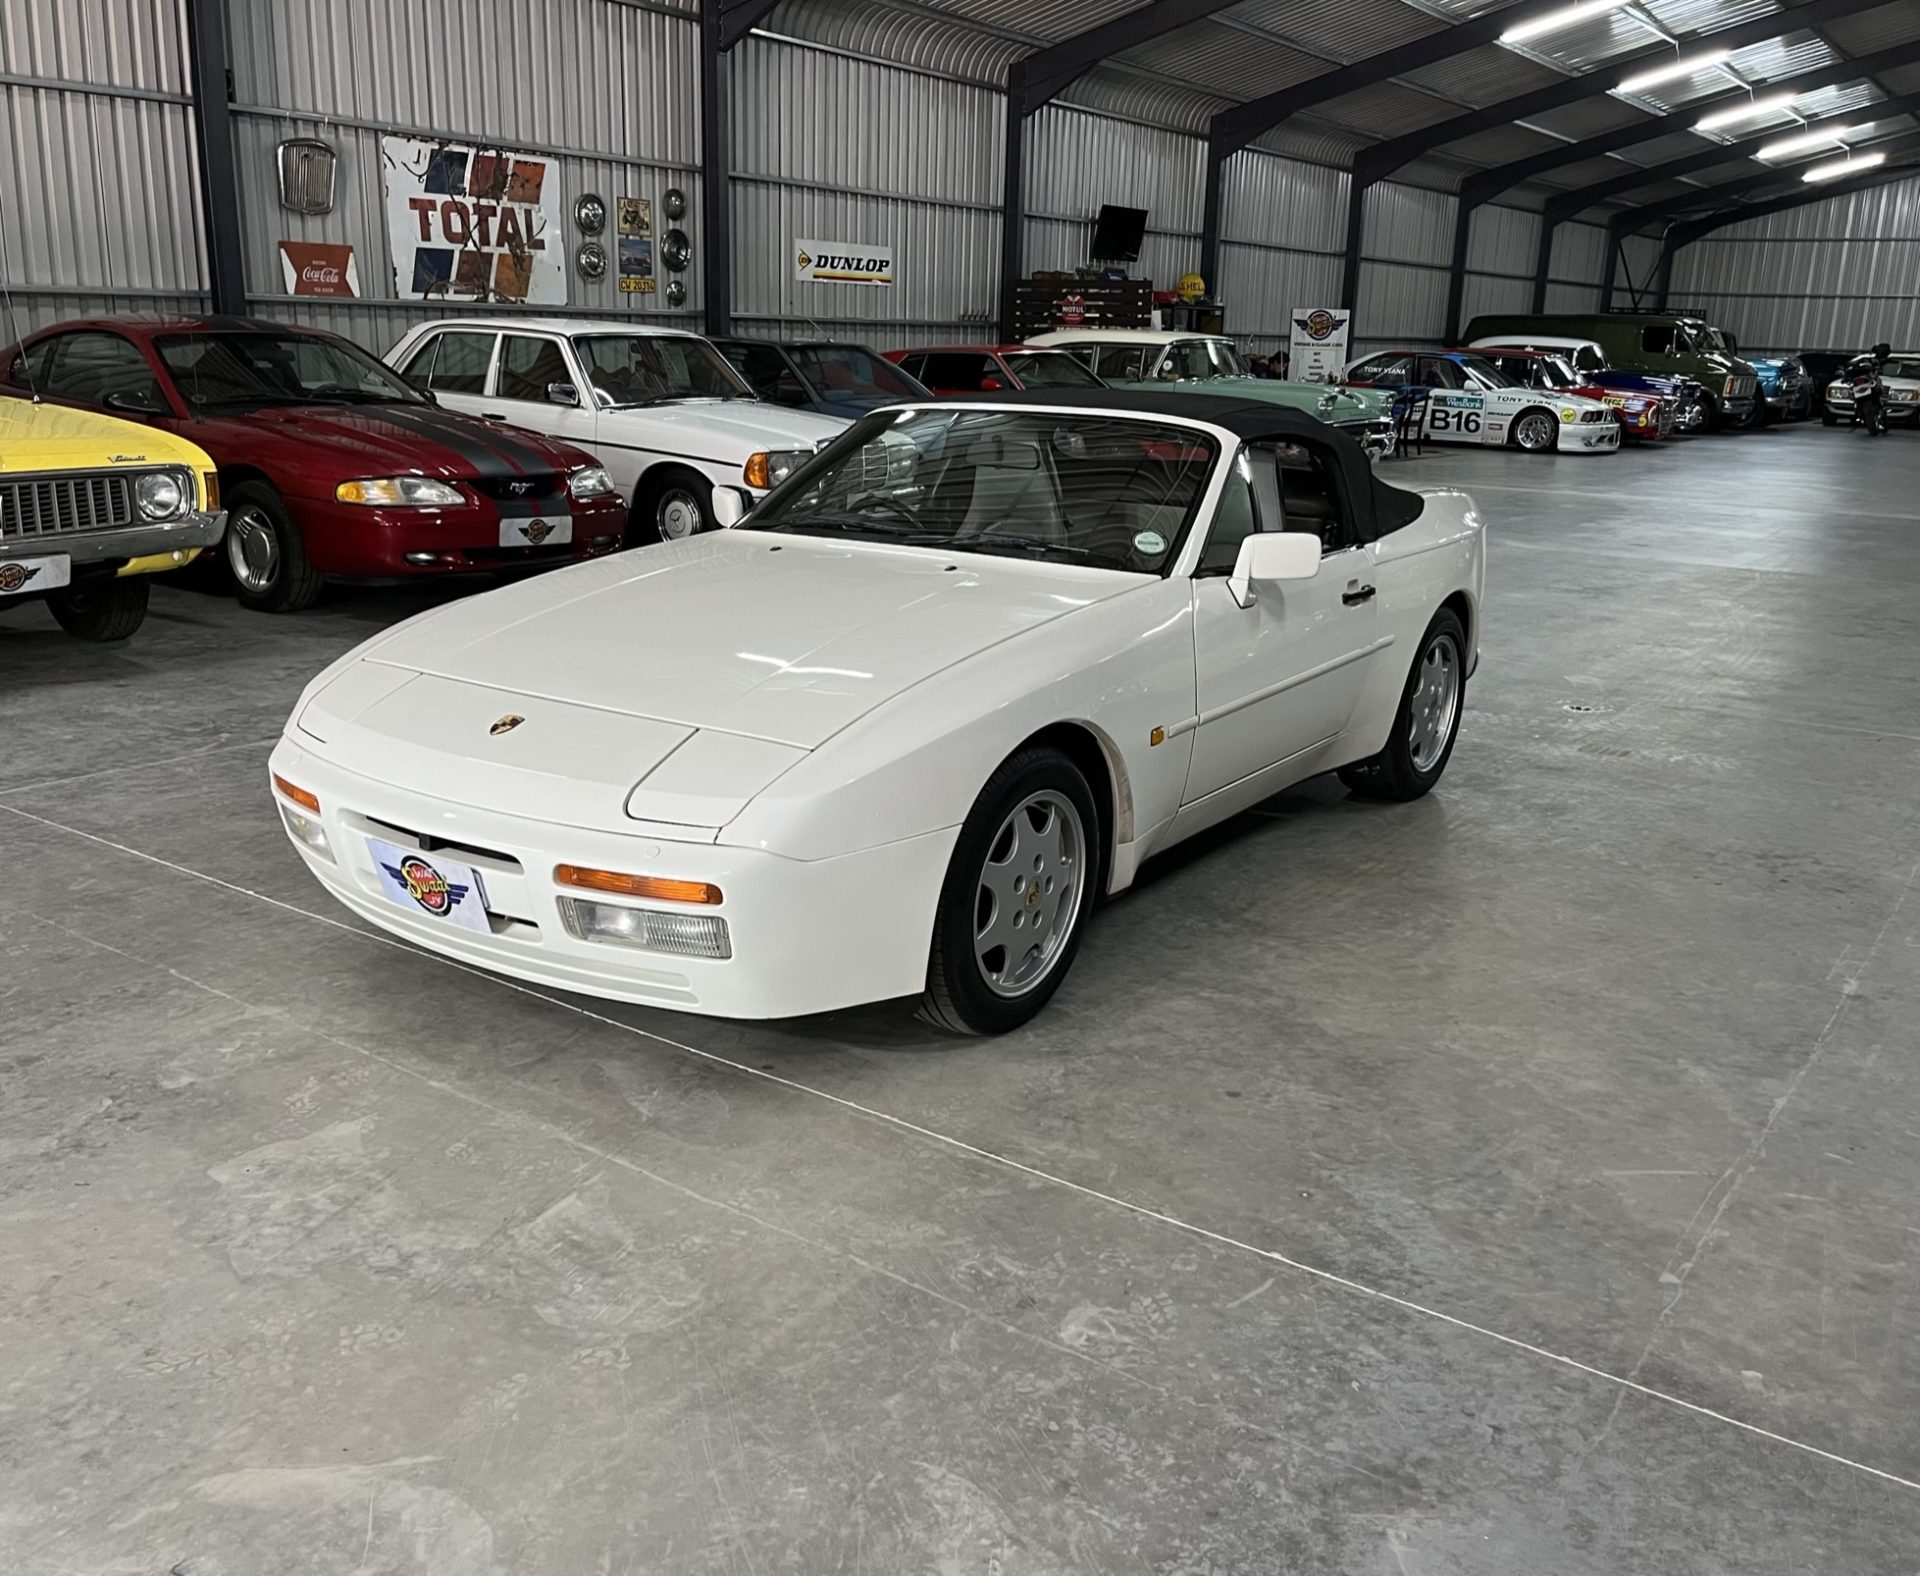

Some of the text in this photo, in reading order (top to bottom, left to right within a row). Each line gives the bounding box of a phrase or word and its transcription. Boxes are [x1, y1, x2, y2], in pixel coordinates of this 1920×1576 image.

[409, 197, 546, 250] TOTAL
[814, 254, 890, 272] DUNLOP
[1062, 305, 1085, 313] MOTUL
[1383, 367, 1405, 375] VIANA
[1446, 396, 1482, 408] WesBank
[1497, 395, 1521, 403] TONY
[1430, 408, 1482, 433] B16
